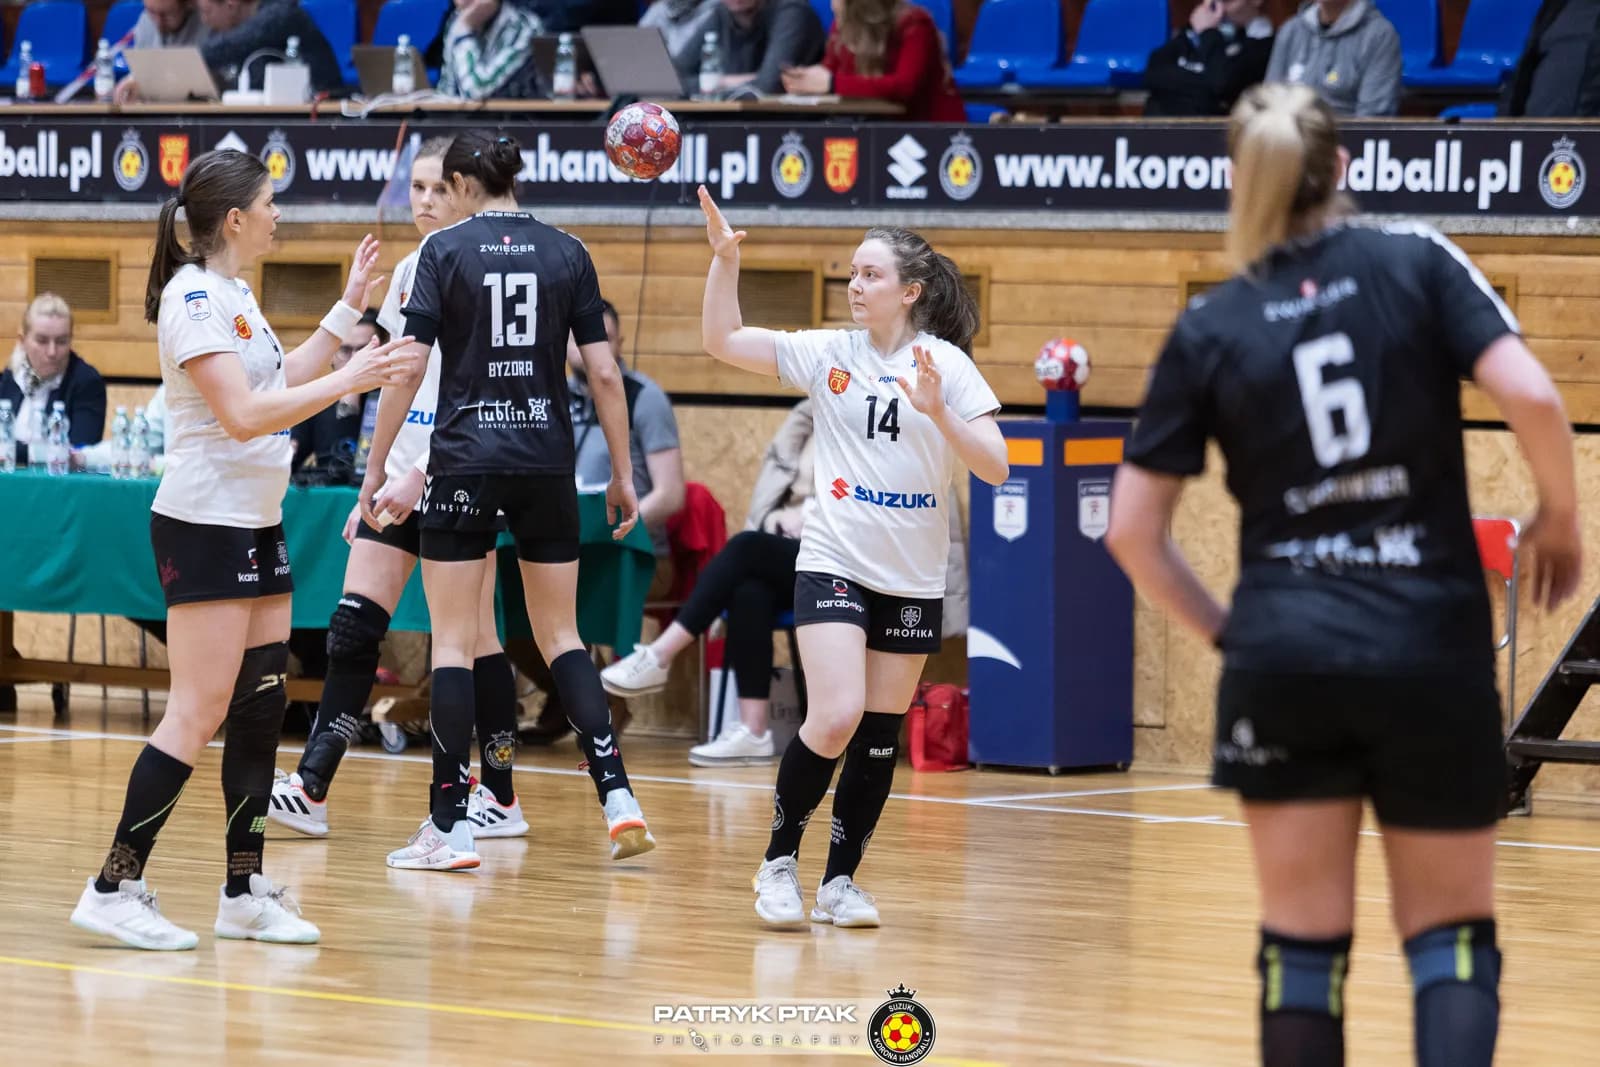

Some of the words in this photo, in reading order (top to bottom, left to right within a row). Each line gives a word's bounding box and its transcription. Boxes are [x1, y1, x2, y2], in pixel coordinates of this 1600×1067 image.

[995, 138, 1522, 210] www.korondball.pl
[480, 244, 535, 253] ZWIEGER
[483, 272, 537, 347] 13
[488, 360, 533, 378] BYZORA
[1293, 332, 1370, 468] 6
[865, 395, 900, 442] 14
[854, 484, 937, 509] SUZUKI
[885, 628, 933, 638] PROFIKA
